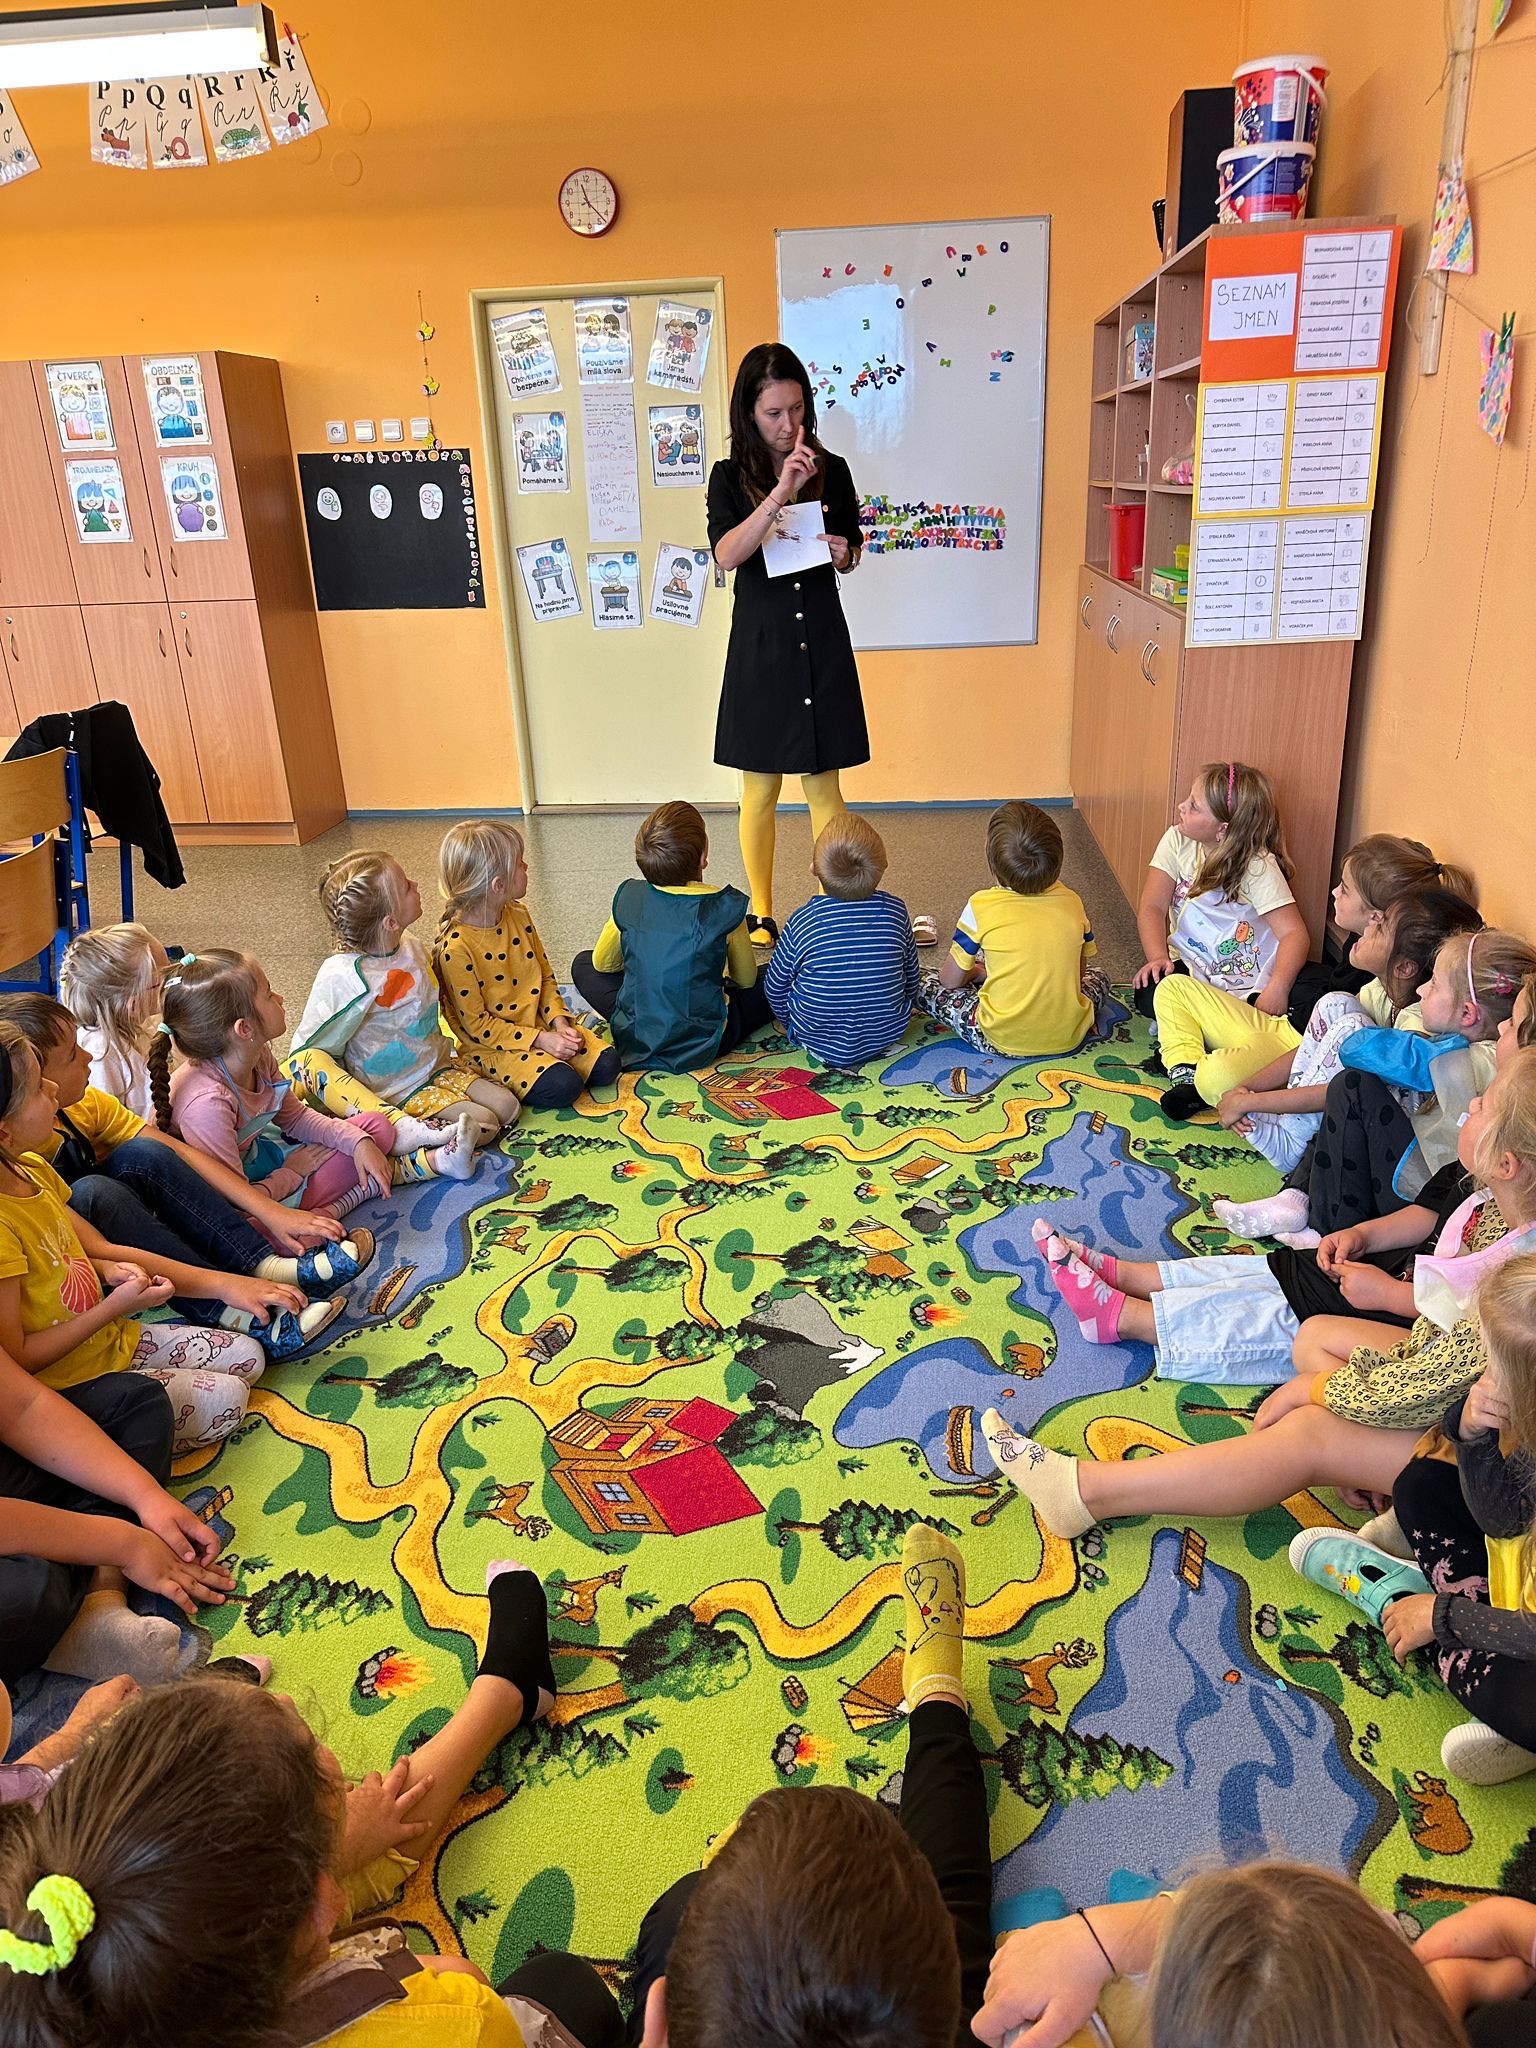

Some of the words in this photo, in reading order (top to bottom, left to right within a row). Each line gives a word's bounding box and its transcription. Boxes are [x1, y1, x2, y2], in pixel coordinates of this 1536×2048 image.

[97, 81, 110, 100] P
[122, 88, 135, 109] p
[146, 84, 165, 110] Q
[178, 88, 192, 110] q
[204, 75, 224, 99] R
[234, 73, 244, 91] r
[583, 175, 589, 183] 12
[595, 177, 598, 185] 1
[567, 188, 573, 196] 10
[570, 211, 573, 219] 8
[1217, 282, 1286, 305] SEZNAM
[1233, 310, 1278, 329] JMEN
[177, 462, 199, 473] KRUH
[699, 554, 704, 562] 8
